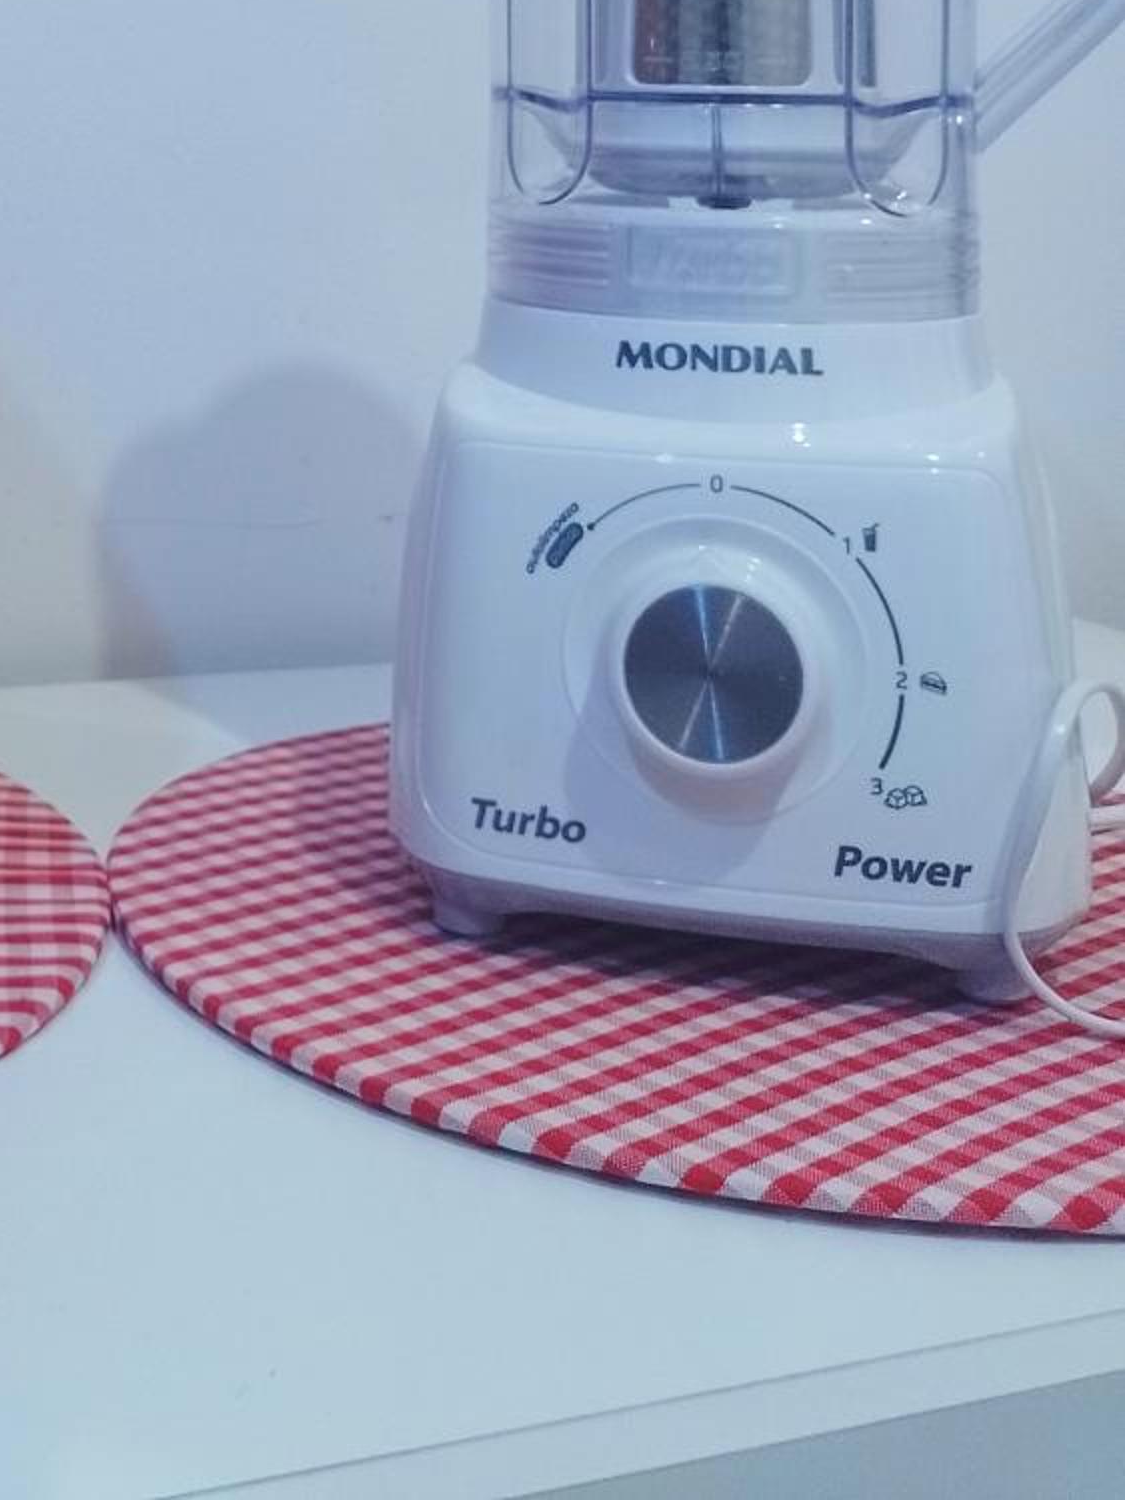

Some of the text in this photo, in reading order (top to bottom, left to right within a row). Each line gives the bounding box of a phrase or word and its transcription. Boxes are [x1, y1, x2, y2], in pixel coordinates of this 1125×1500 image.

[615, 339, 824, 376] MONDIAL
[709, 474, 724, 493] 0
[842, 536, 852, 554] 1
[895, 671, 908, 690] 2
[870, 777, 884, 796] 3
[471, 797, 587, 844] Turbo
[833, 844, 972, 890] Power
